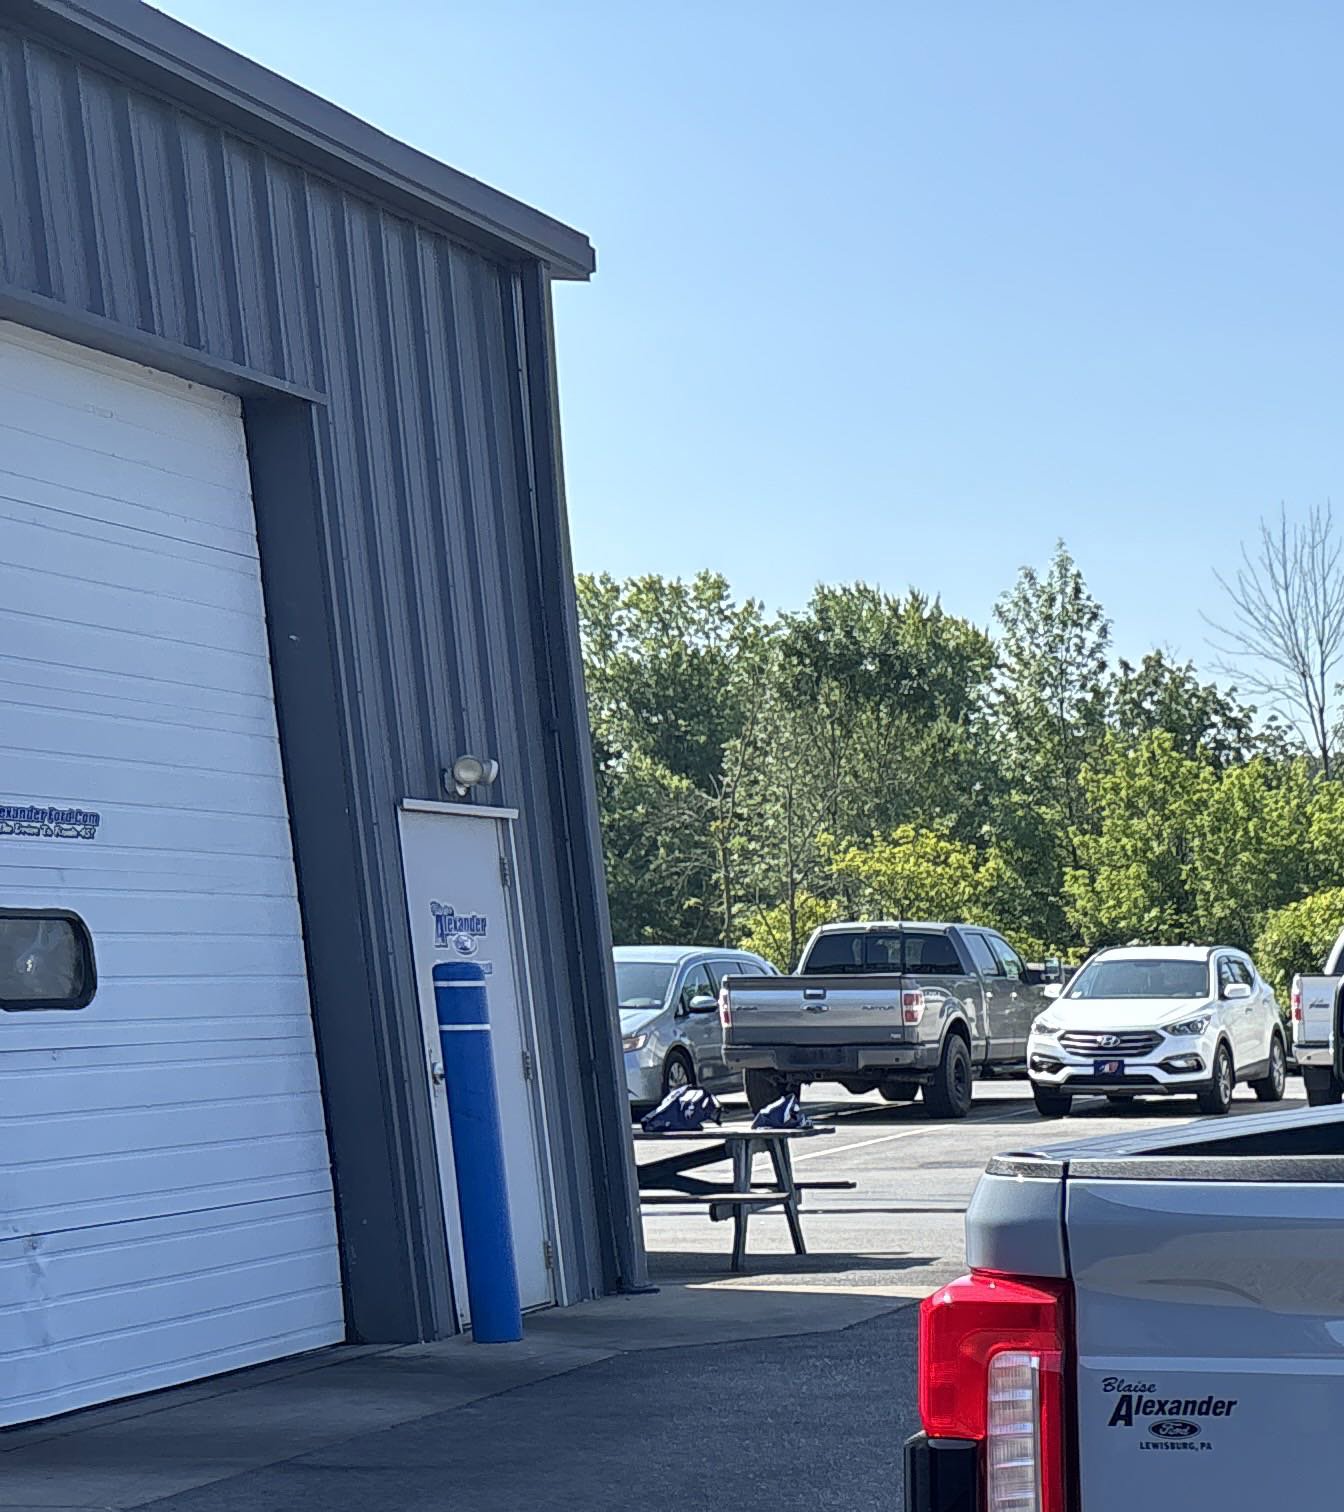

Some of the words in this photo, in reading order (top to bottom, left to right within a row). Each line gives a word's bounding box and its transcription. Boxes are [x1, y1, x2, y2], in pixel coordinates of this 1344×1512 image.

[1102, 1377, 1157, 1393] Blaise
[1108, 1394, 1238, 1427] Alexander
[1139, 1441, 1199, 1452] LEWISBURG,
[1200, 1441, 1213, 1450] PA
